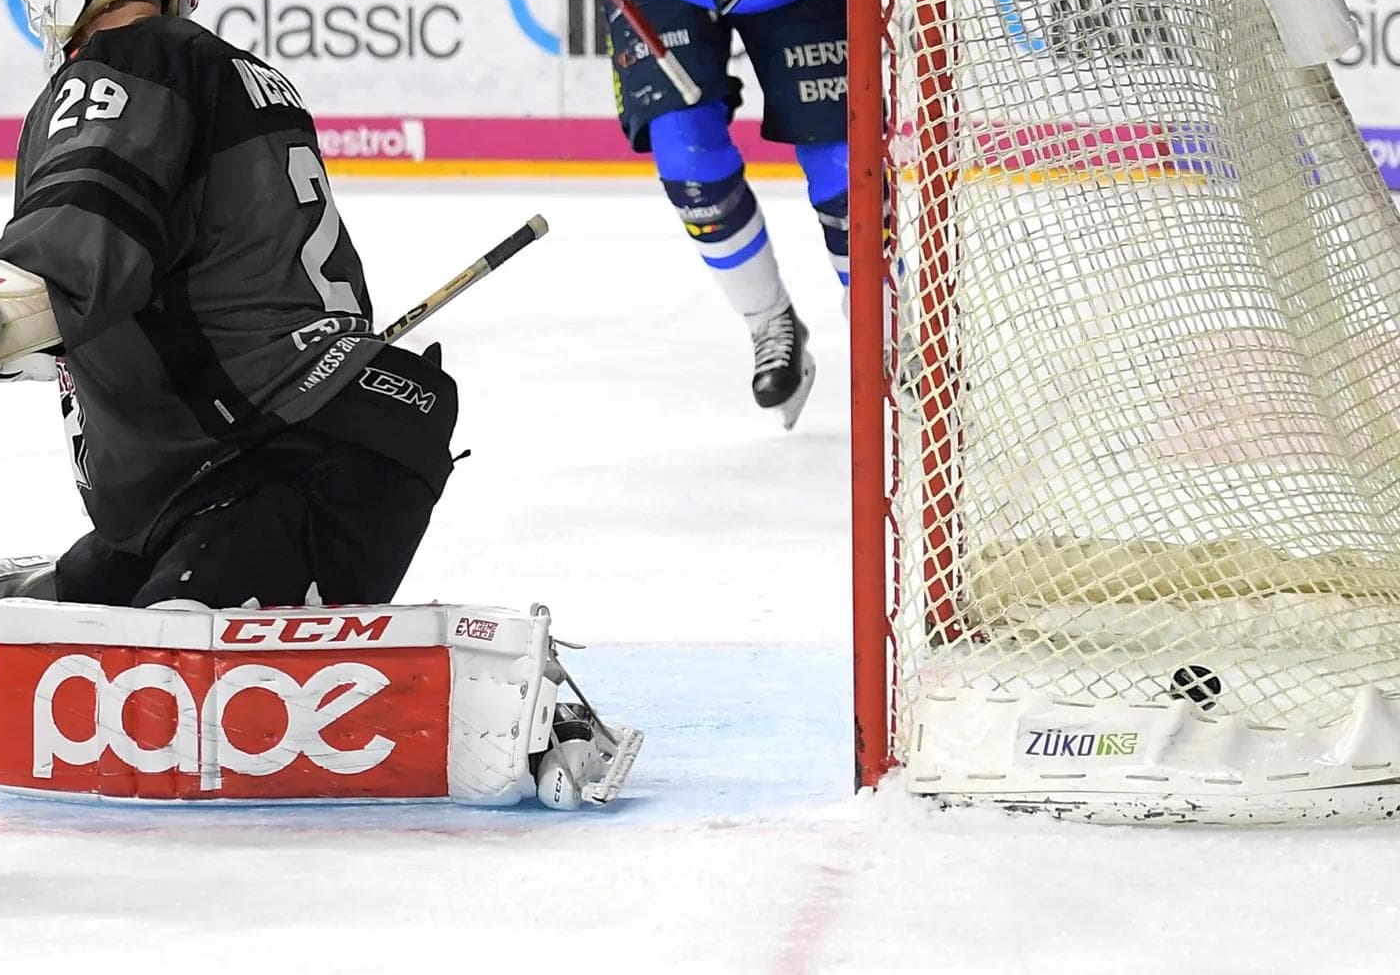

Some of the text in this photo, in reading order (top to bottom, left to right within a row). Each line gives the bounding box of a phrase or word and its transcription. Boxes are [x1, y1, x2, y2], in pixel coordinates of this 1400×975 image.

[47, 77, 130, 140] 29
[219, 615, 393, 643] CCM
[32, 654, 397, 791] pape
